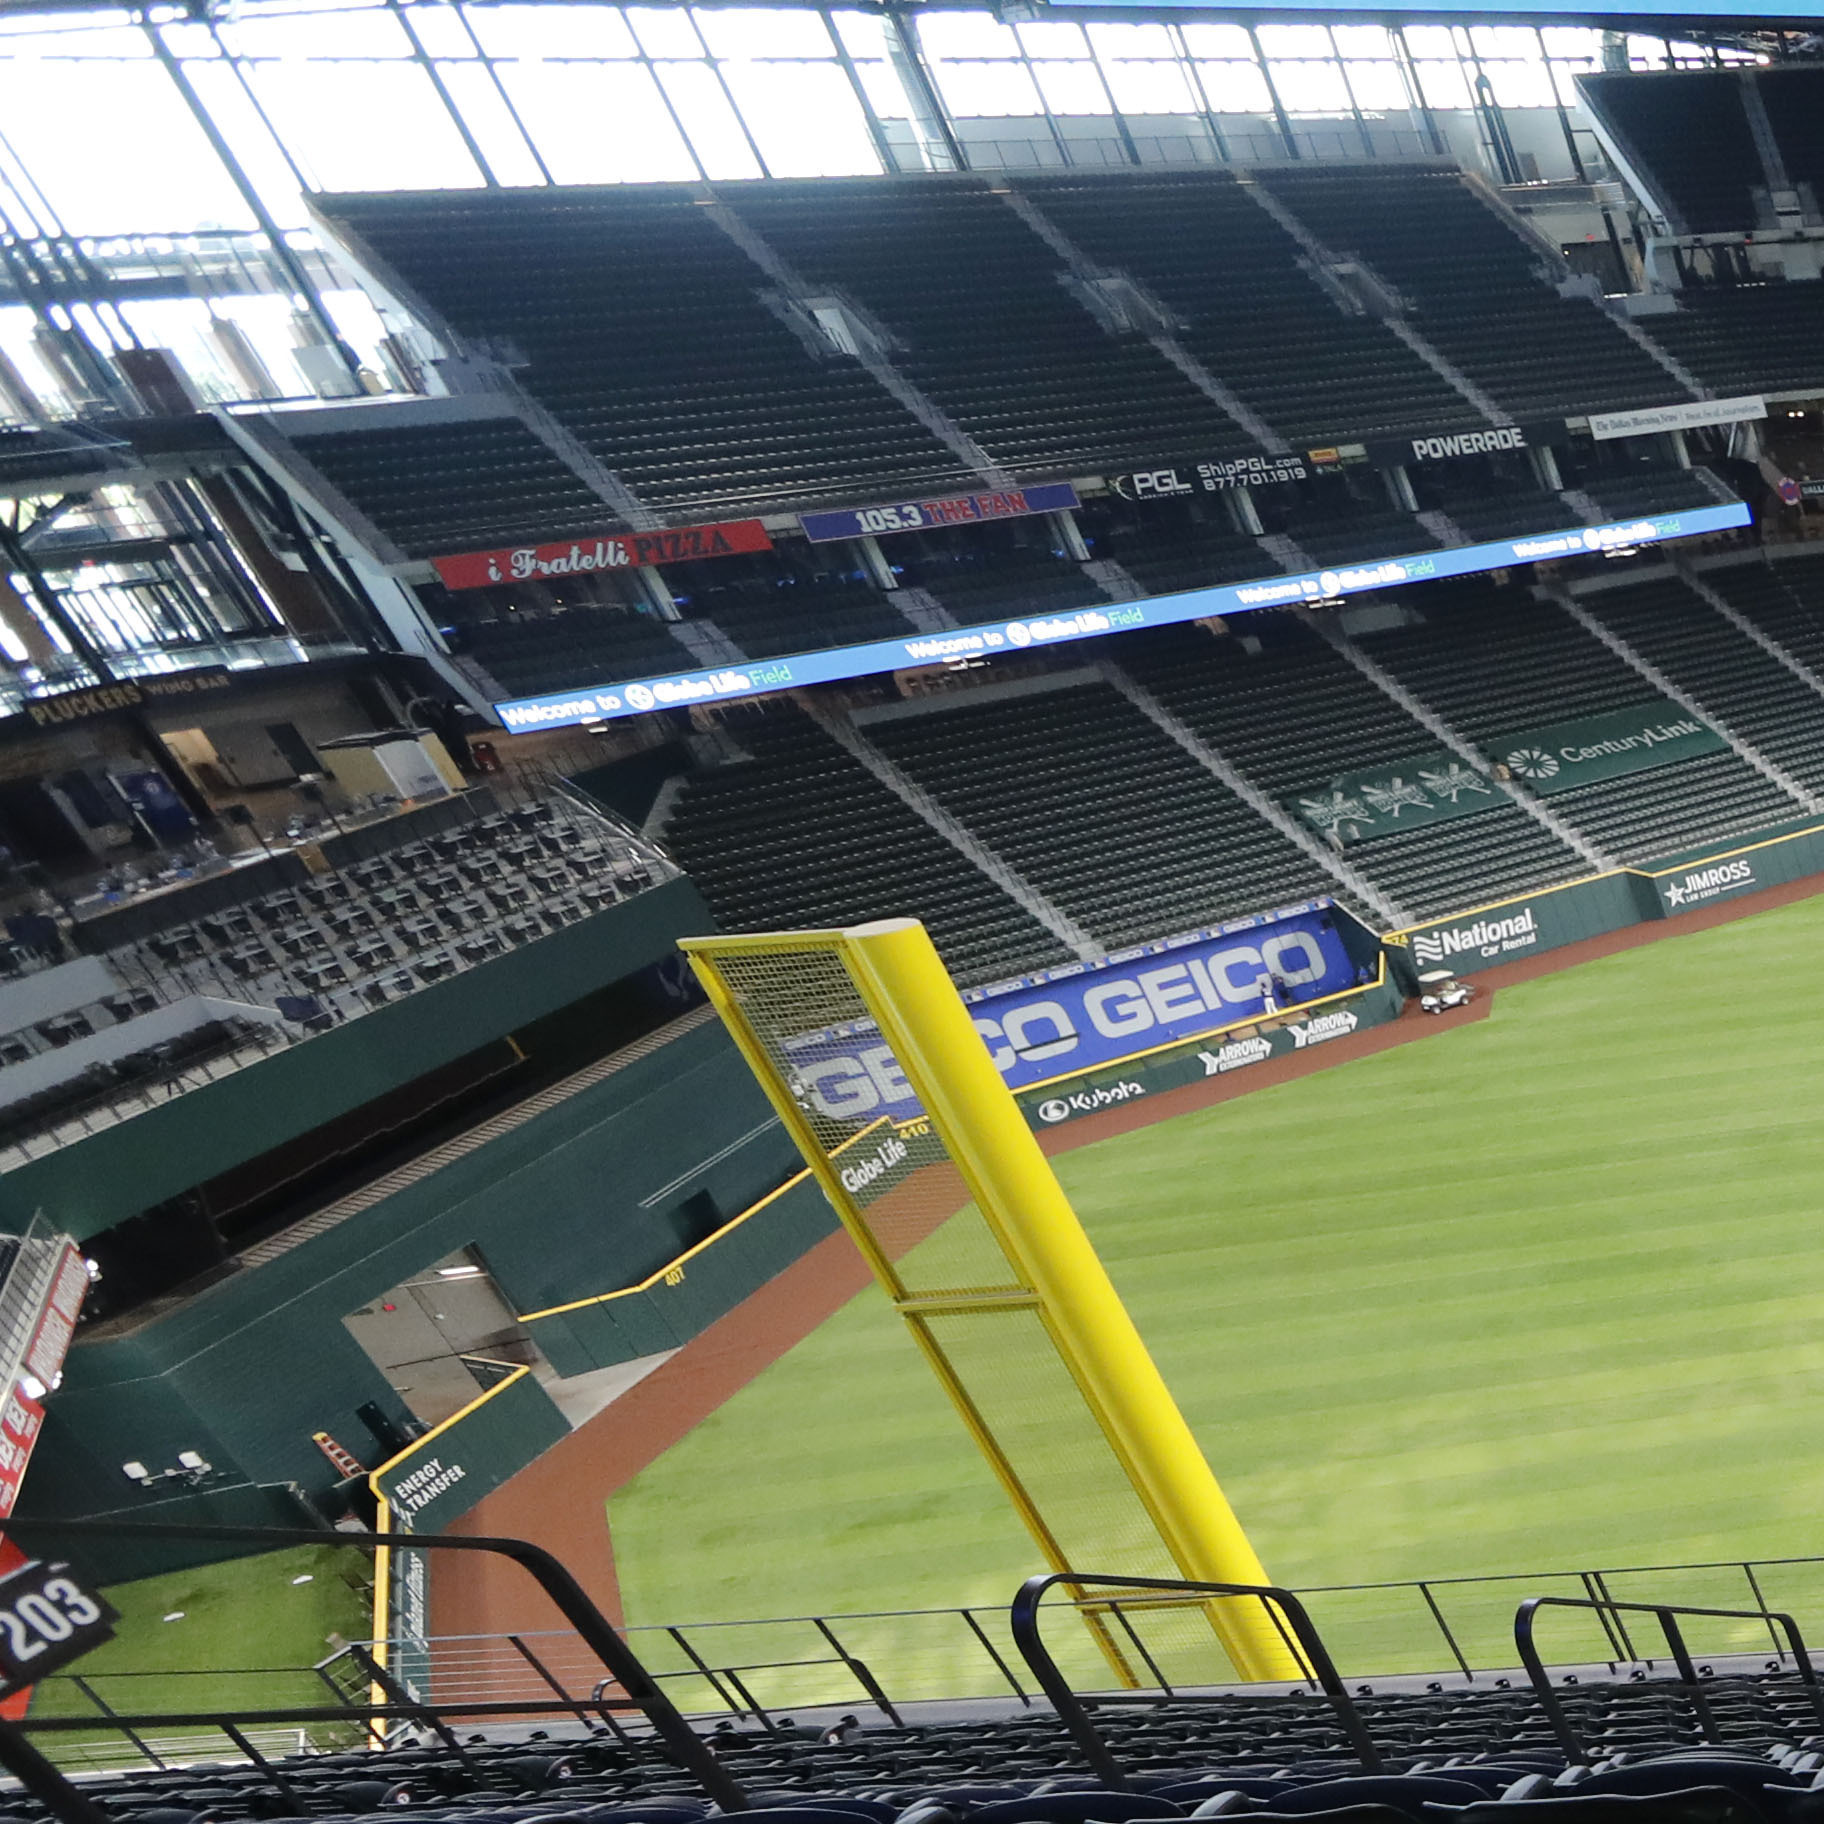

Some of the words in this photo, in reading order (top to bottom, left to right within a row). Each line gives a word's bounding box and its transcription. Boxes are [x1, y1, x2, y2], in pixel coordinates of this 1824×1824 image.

[1412, 426, 1528, 460] POWERADE
[1133, 469, 1192, 495] PGL
[1197, 456, 1302, 478] ShipPGL.com
[1203, 467, 1307, 491] 877.701.1919
[855, 508, 924, 532] 105.3
[924, 499, 975, 523] THE
[979, 492, 1030, 518] FAN
[510, 541, 629, 579] Fratelli
[634, 529, 733, 563] PIZZA
[1236, 582, 1301, 603] Welcome
[1301, 580, 1318, 593] to
[1405, 559, 1435, 576] Field
[905, 636, 983, 659] Welcome
[983, 632, 1004, 646] to
[1108, 607, 1144, 626] Field
[28, 684, 142, 726] PLUCKERS
[500, 700, 596, 725] Welcome
[597, 695, 621, 710] to
[749, 665, 792, 687] Field
[1559, 718, 1701, 764] CenturyLink
[1480, 944, 1499, 957] Car
[1502, 933, 1536, 951] Rental
[1084, 931, 1326, 1039] GEICO
[1308, 1012, 1350, 1035] ARROW
[1219, 1038, 1263, 1063] ARROW
[1069, 1081, 1146, 1109] Kubota
[840, 1156, 884, 1193] Globe
[876, 1138, 907, 1168] Life
[665, 1265, 685, 1287] 407
[395, 1458, 444, 1498] ENERGY
[406, 1464, 466, 1513] TRANSFER
[0, 1578, 101, 1662] 203
